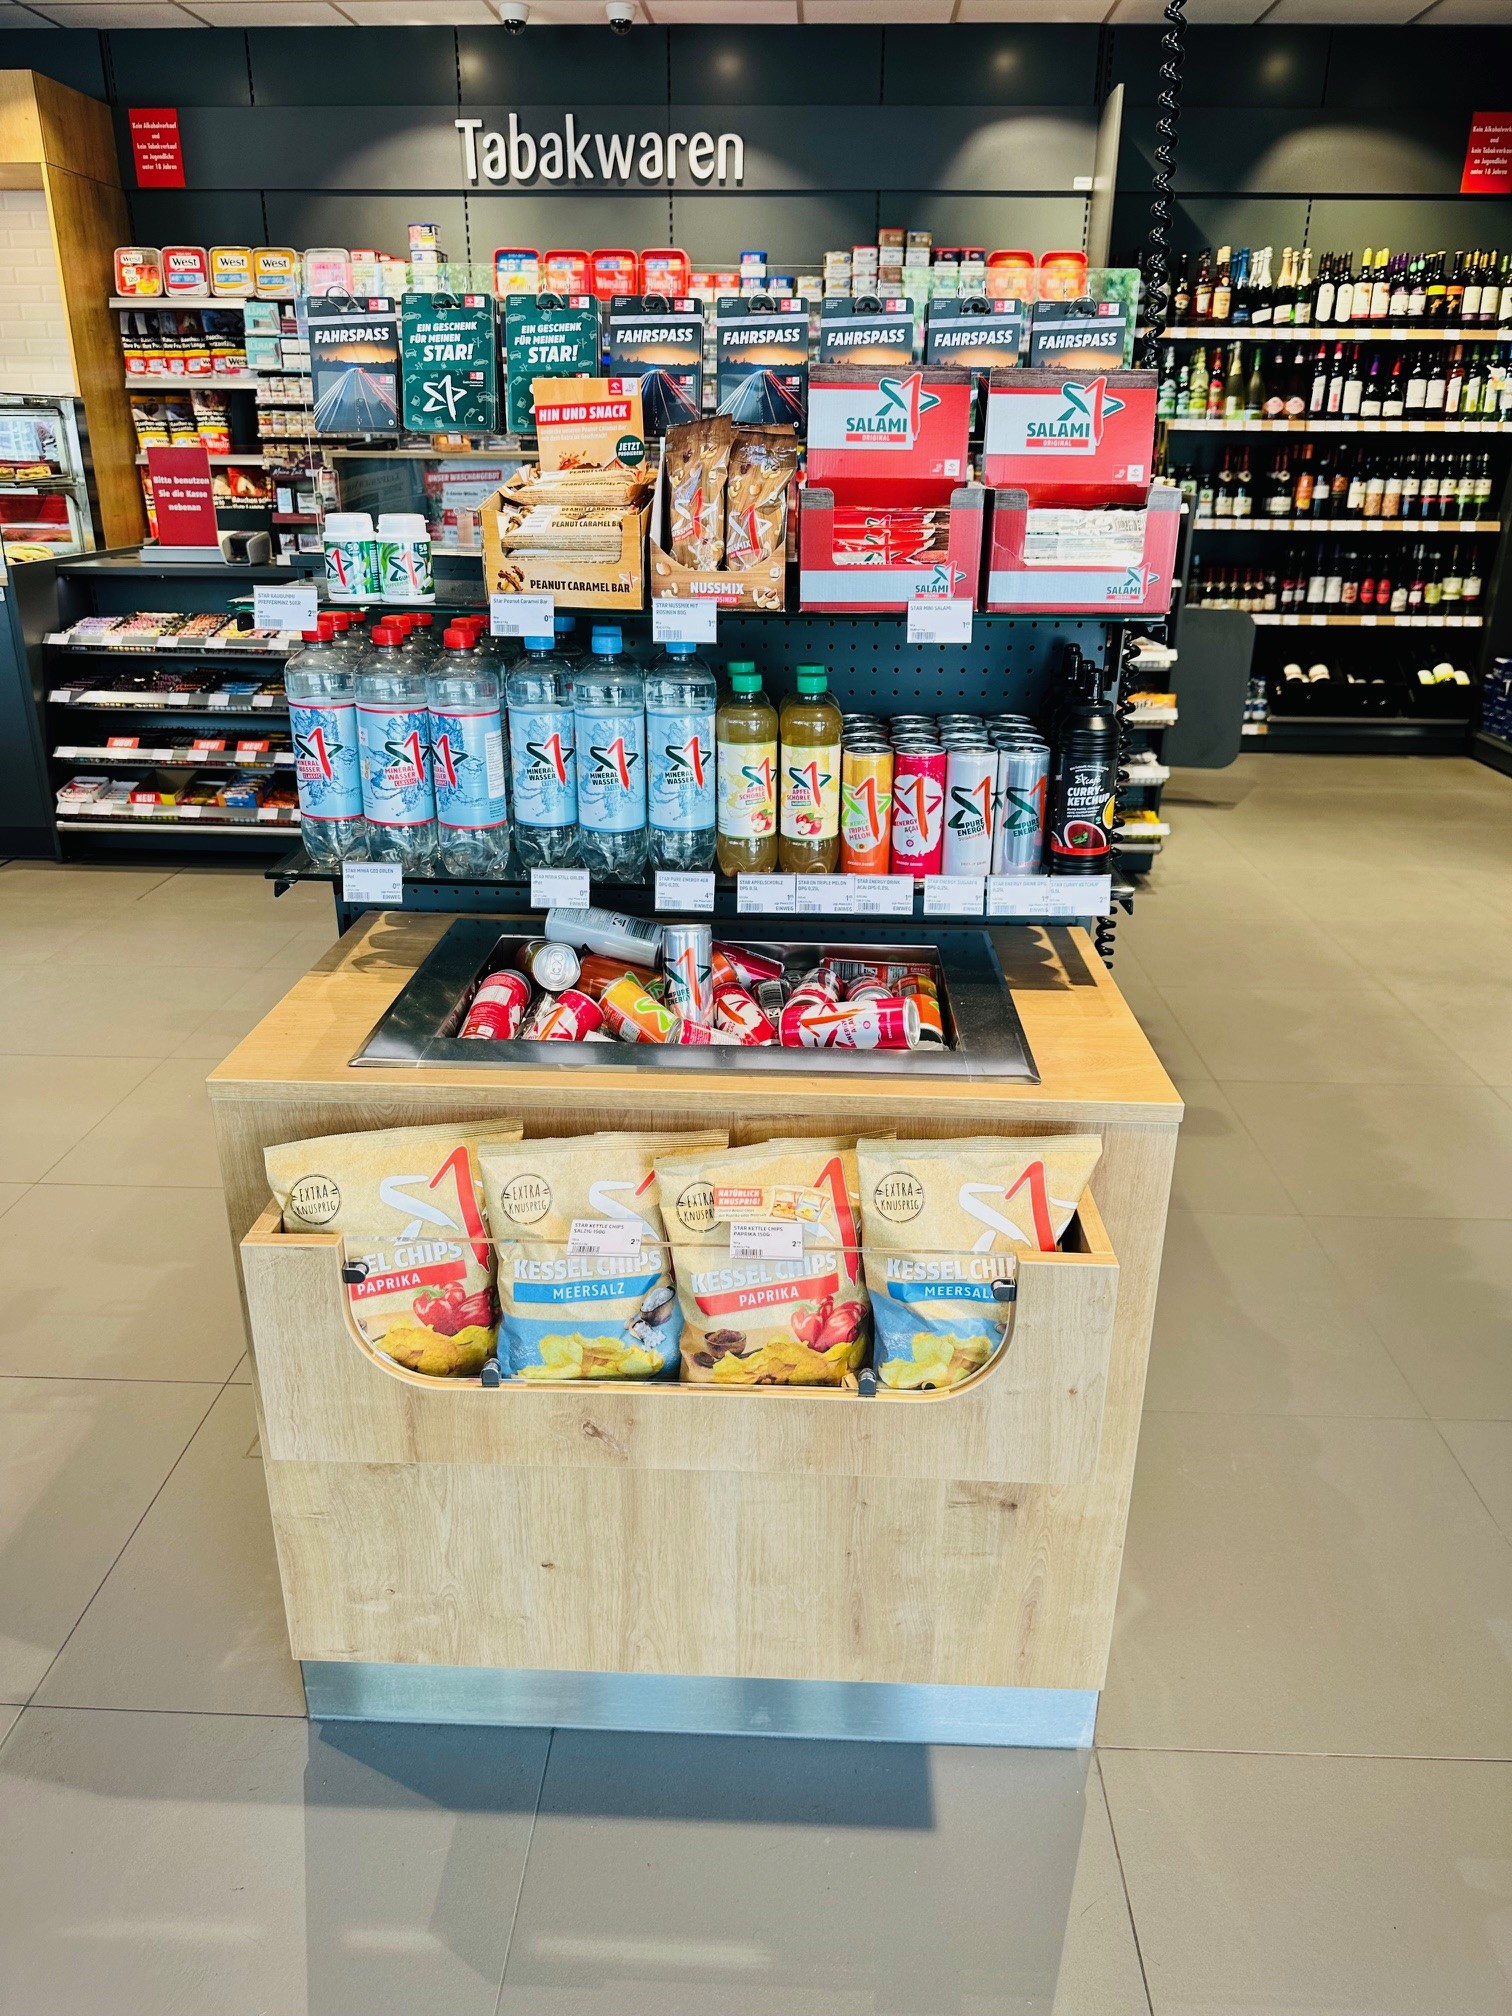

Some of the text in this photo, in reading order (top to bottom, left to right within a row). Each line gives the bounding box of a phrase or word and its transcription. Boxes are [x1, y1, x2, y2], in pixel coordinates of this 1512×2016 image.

[454, 112, 744, 180] Tabakwaren
[150, 153, 174, 162] Jugendliche
[172, 257, 198, 266] West
[220, 258, 245, 266] West
[262, 258, 288, 268] West
[417, 321, 478, 332] EIN GESCHENK
[522, 322, 582, 334] EIN GESCHENK
[314, 328, 389, 344] FAHRSPASS
[410, 333, 460, 344] FÜR MEINEN
[514, 334, 566, 346] FÜR MEINEN
[616, 328, 694, 343] FAHRSPASS
[723, 328, 800, 345] FAHRSPASS
[826, 329, 905, 346] FAHRSPASS
[934, 330, 1013, 348] FAHRSPASS
[1038, 332, 1118, 350] FAHRSPASS
[423, 343, 474, 362] STAR!
[528, 344, 578, 364] STAR!
[539, 404, 628, 422] HIN UND SNACK
[846, 418, 908, 432] SALAMI
[1027, 422, 1090, 438] SALAMI
[618, 442, 641, 452] JETZT
[1043, 439, 1072, 447] ORIGINAL
[153, 476, 210, 484] Bitte benutzen
[158, 489, 208, 498] Sie die Kasse
[168, 503, 202, 511] nebenan
[418, 544, 428, 552] 50
[530, 579, 630, 592] PEANUT CARAMEL BAR
[690, 582, 744, 594] NUSSMIX
[916, 584, 948, 593] SALAMI
[1106, 586, 1140, 594] SALAMI
[384, 766, 414, 774] MINERAL
[388, 772, 416, 781] WASSER
[739, 792, 765, 800] SCHORLE
[1067, 786, 1104, 797] CURRY-
[136, 794, 155, 802] NEU!
[1067, 793, 1110, 806] KETCHUP
[896, 819, 918, 827] ENERGY
[966, 818, 984, 828] PURE
[1022, 818, 1039, 828] PURE
[848, 826, 869, 834] TRIPLE
[957, 826, 985, 837] ENERGY
[1013, 826, 1040, 837] ENERGY
[849, 833, 871, 841] MELON
[673, 988, 690, 997] PURE
[300, 1184, 328, 1203] EXTRA
[513, 1184, 540, 1200] EXTRA
[718, 1188, 760, 1197] NATÜRLICH
[885, 1182, 914, 1198] EXTRA
[686, 1192, 714, 1209] EXTRA
[880, 1199, 920, 1212] KNUSPRIG
[296, 1202, 336, 1216] KNUSPRIG
[508, 1201, 547, 1214] KNUSPRIG
[684, 1208, 714, 1222] KNUSPR
[394, 1241, 462, 1268] CHIPS
[514, 1251, 662, 1281] KESSEL CHIPS
[887, 1257, 968, 1281] KESSEL
[690, 1252, 836, 1294] KESSEL CHIPS
[357, 1272, 422, 1296] PAPRIKA
[554, 1282, 625, 1300] MEERSALZ
[739, 1286, 800, 1307] PAPRIKA
[924, 1286, 994, 1300] MEERSAL
